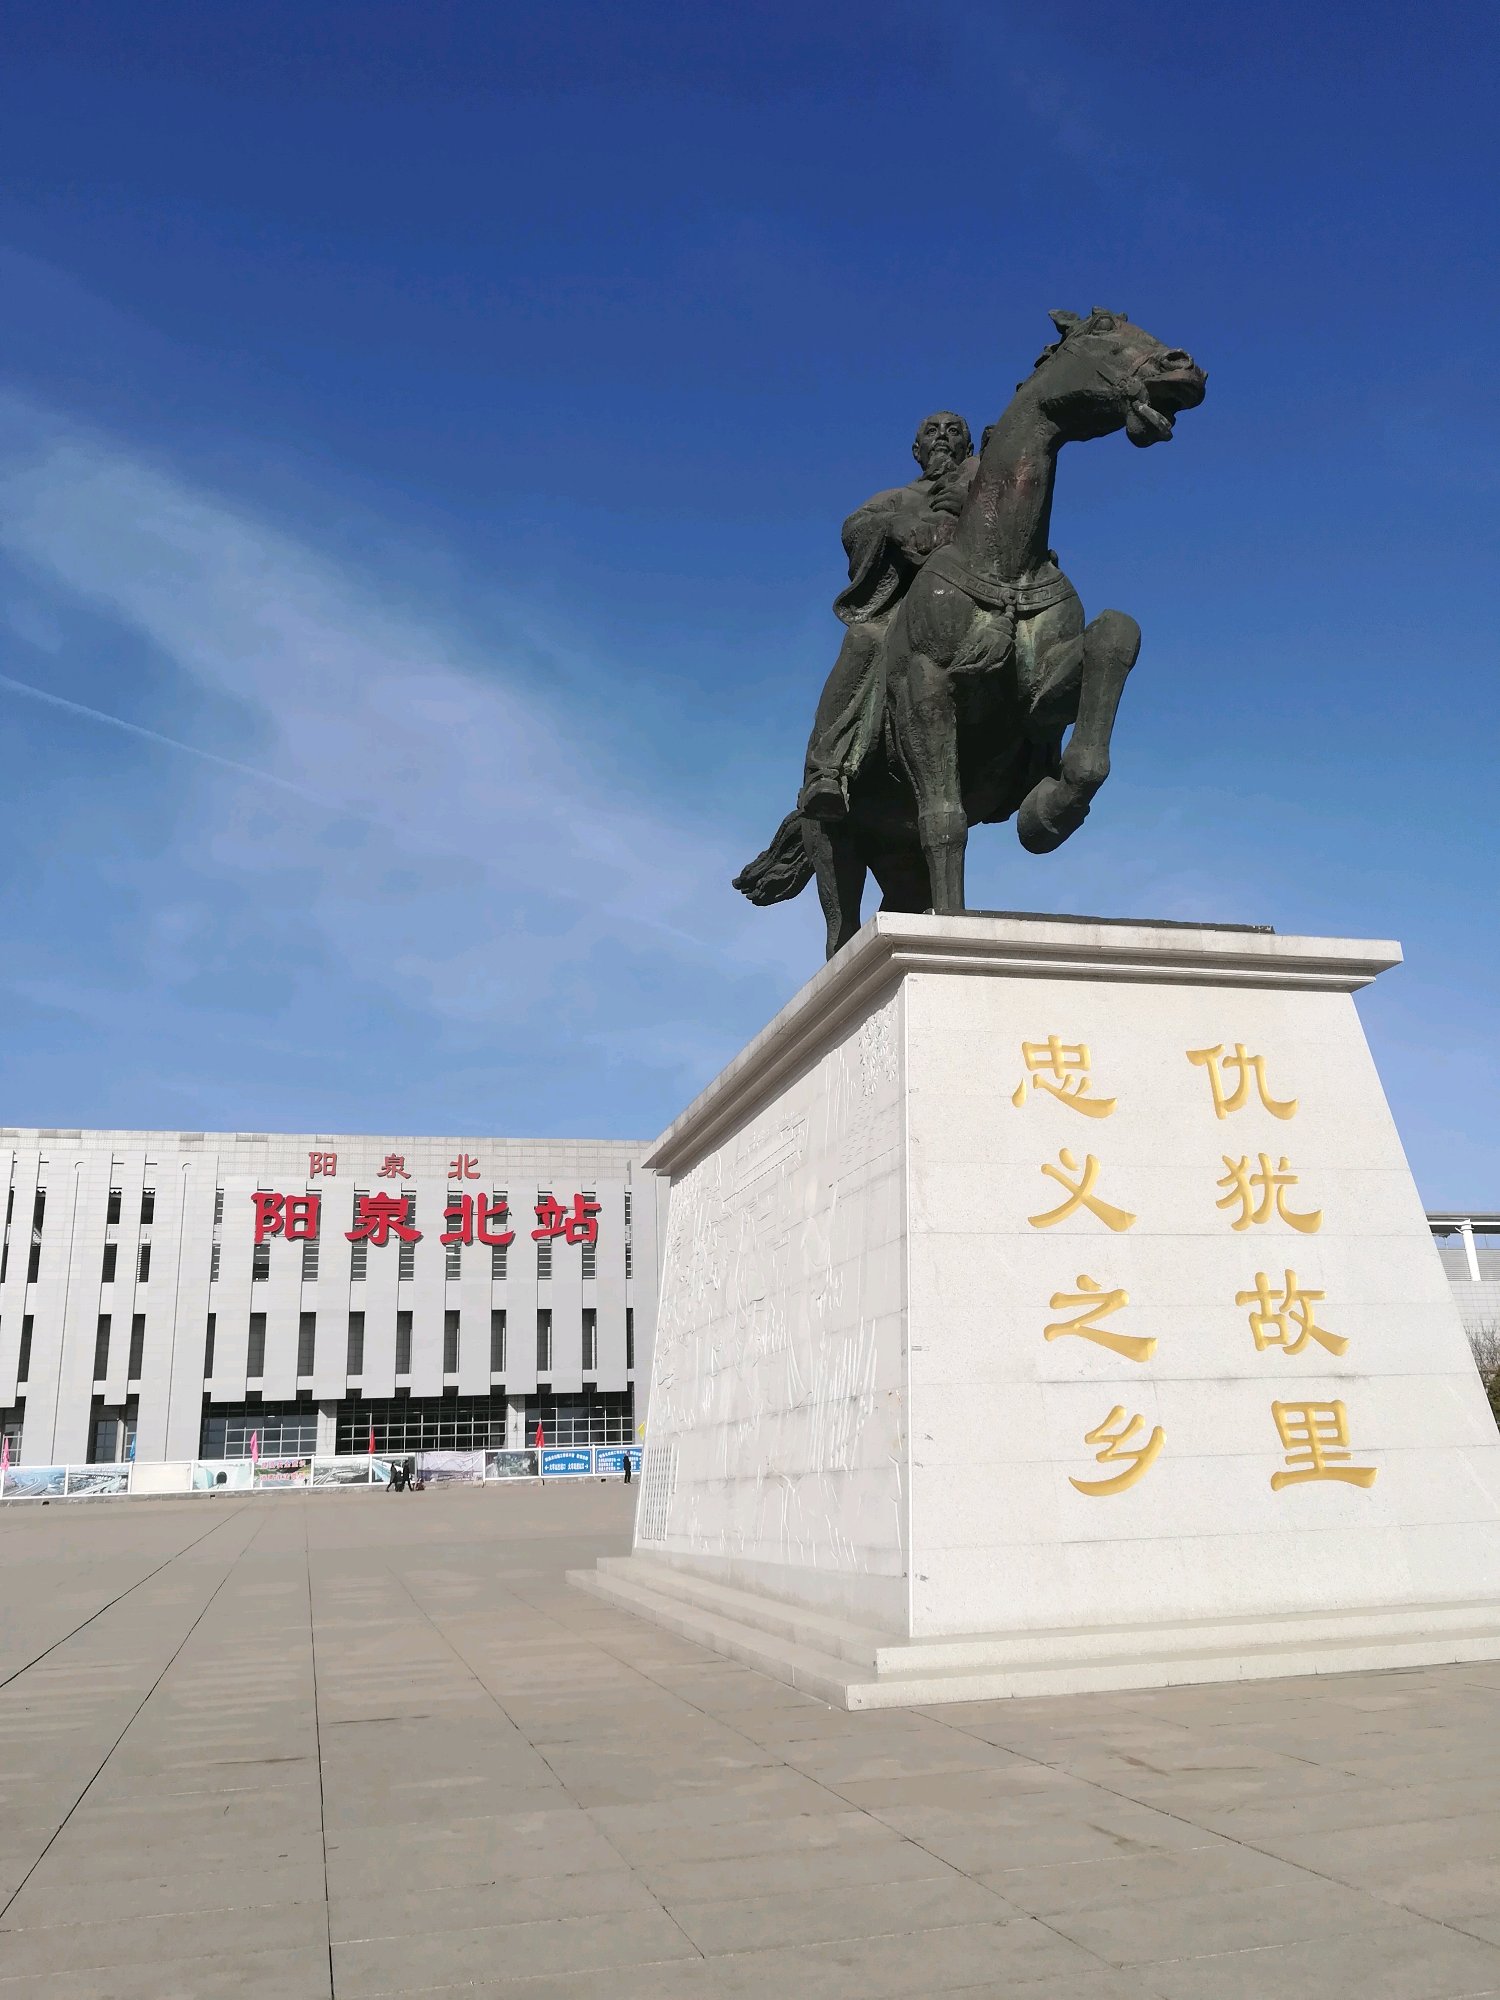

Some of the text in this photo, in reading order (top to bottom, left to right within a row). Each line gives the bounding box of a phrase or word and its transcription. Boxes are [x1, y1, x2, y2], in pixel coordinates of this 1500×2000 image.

[250, 1191, 602, 1246] 阳泉北站
[309, 1151, 481, 1180] 阳泉北
[1011, 1034, 1166, 1497] 忠义之乡
[1185, 1042, 1380, 1492] 仇犹故里
